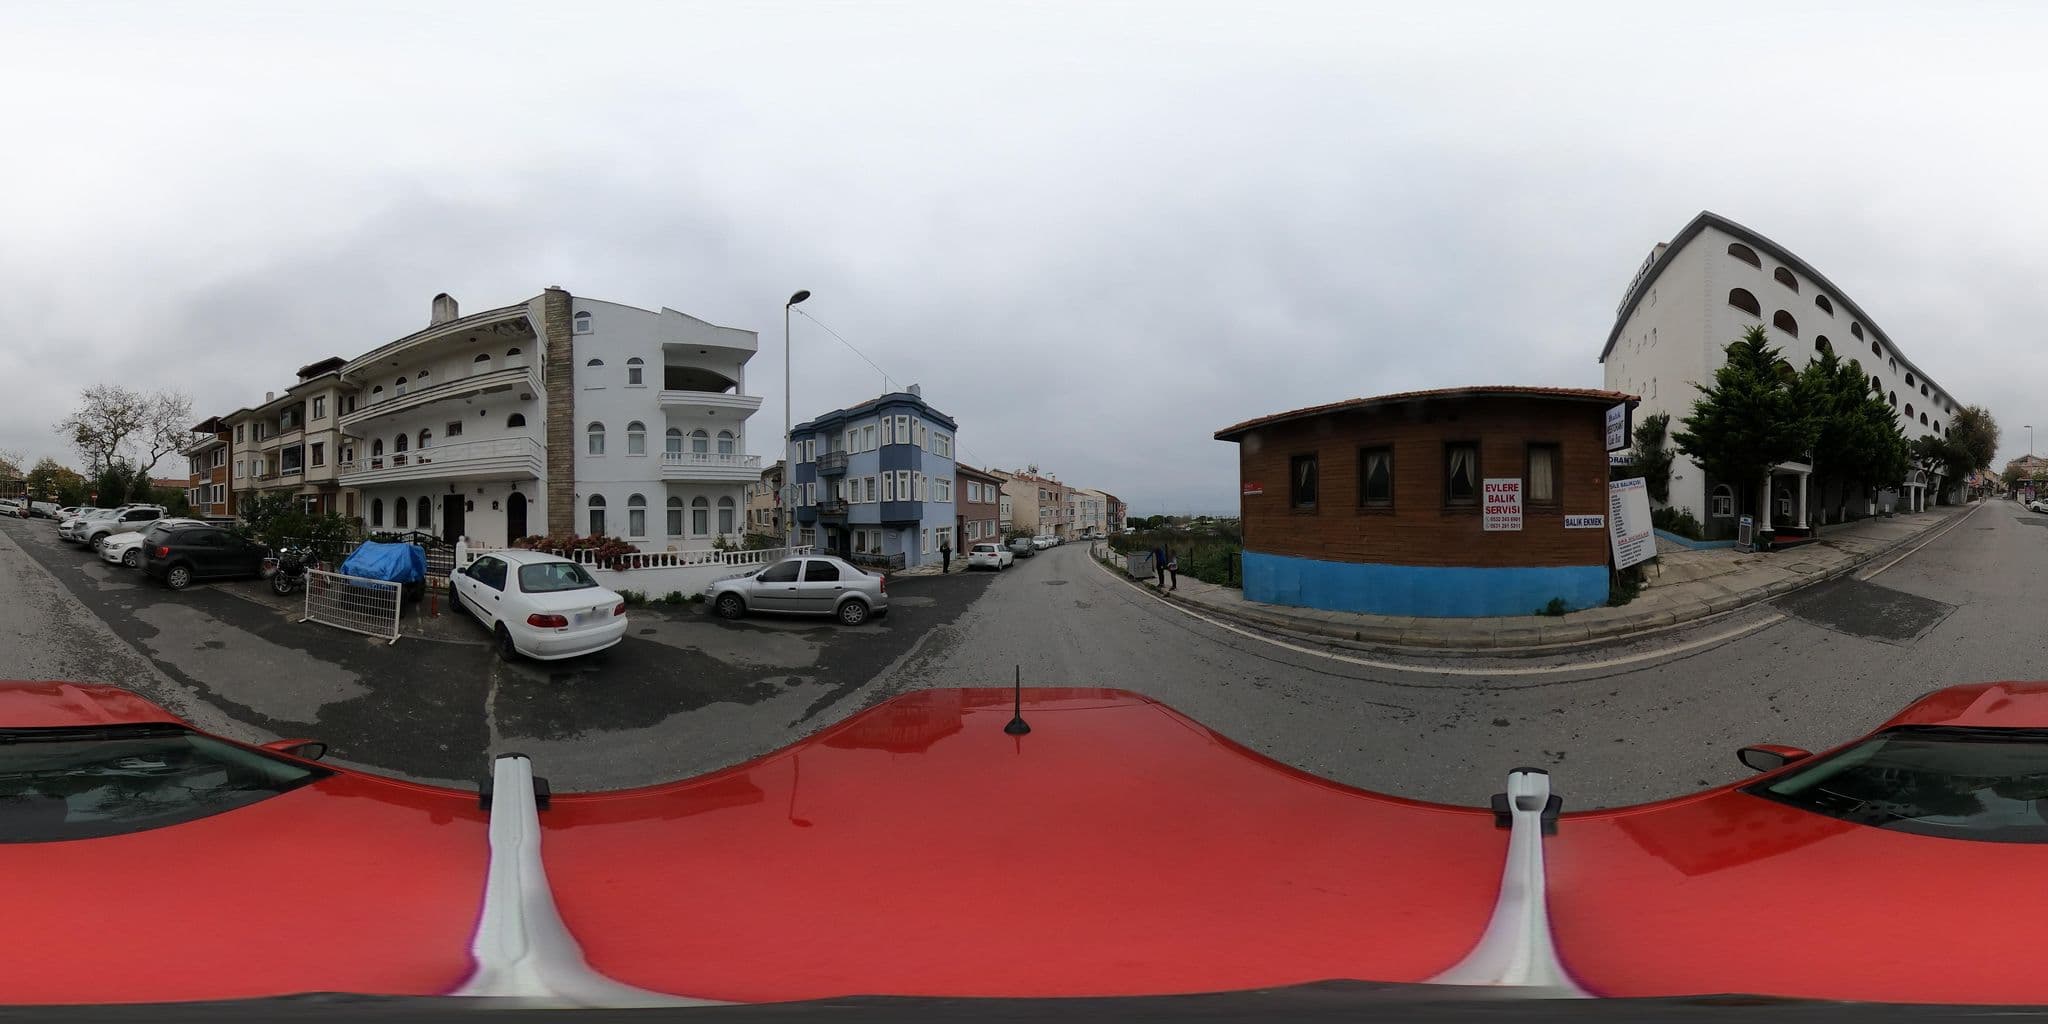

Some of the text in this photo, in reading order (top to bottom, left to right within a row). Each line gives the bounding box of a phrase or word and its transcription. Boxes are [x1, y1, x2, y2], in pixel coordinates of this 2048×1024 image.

[1485, 483, 1519, 492] EVLERE
[1488, 494, 1516, 503] BALIK
[1565, 517, 1602, 527] BALIK EKMEK
